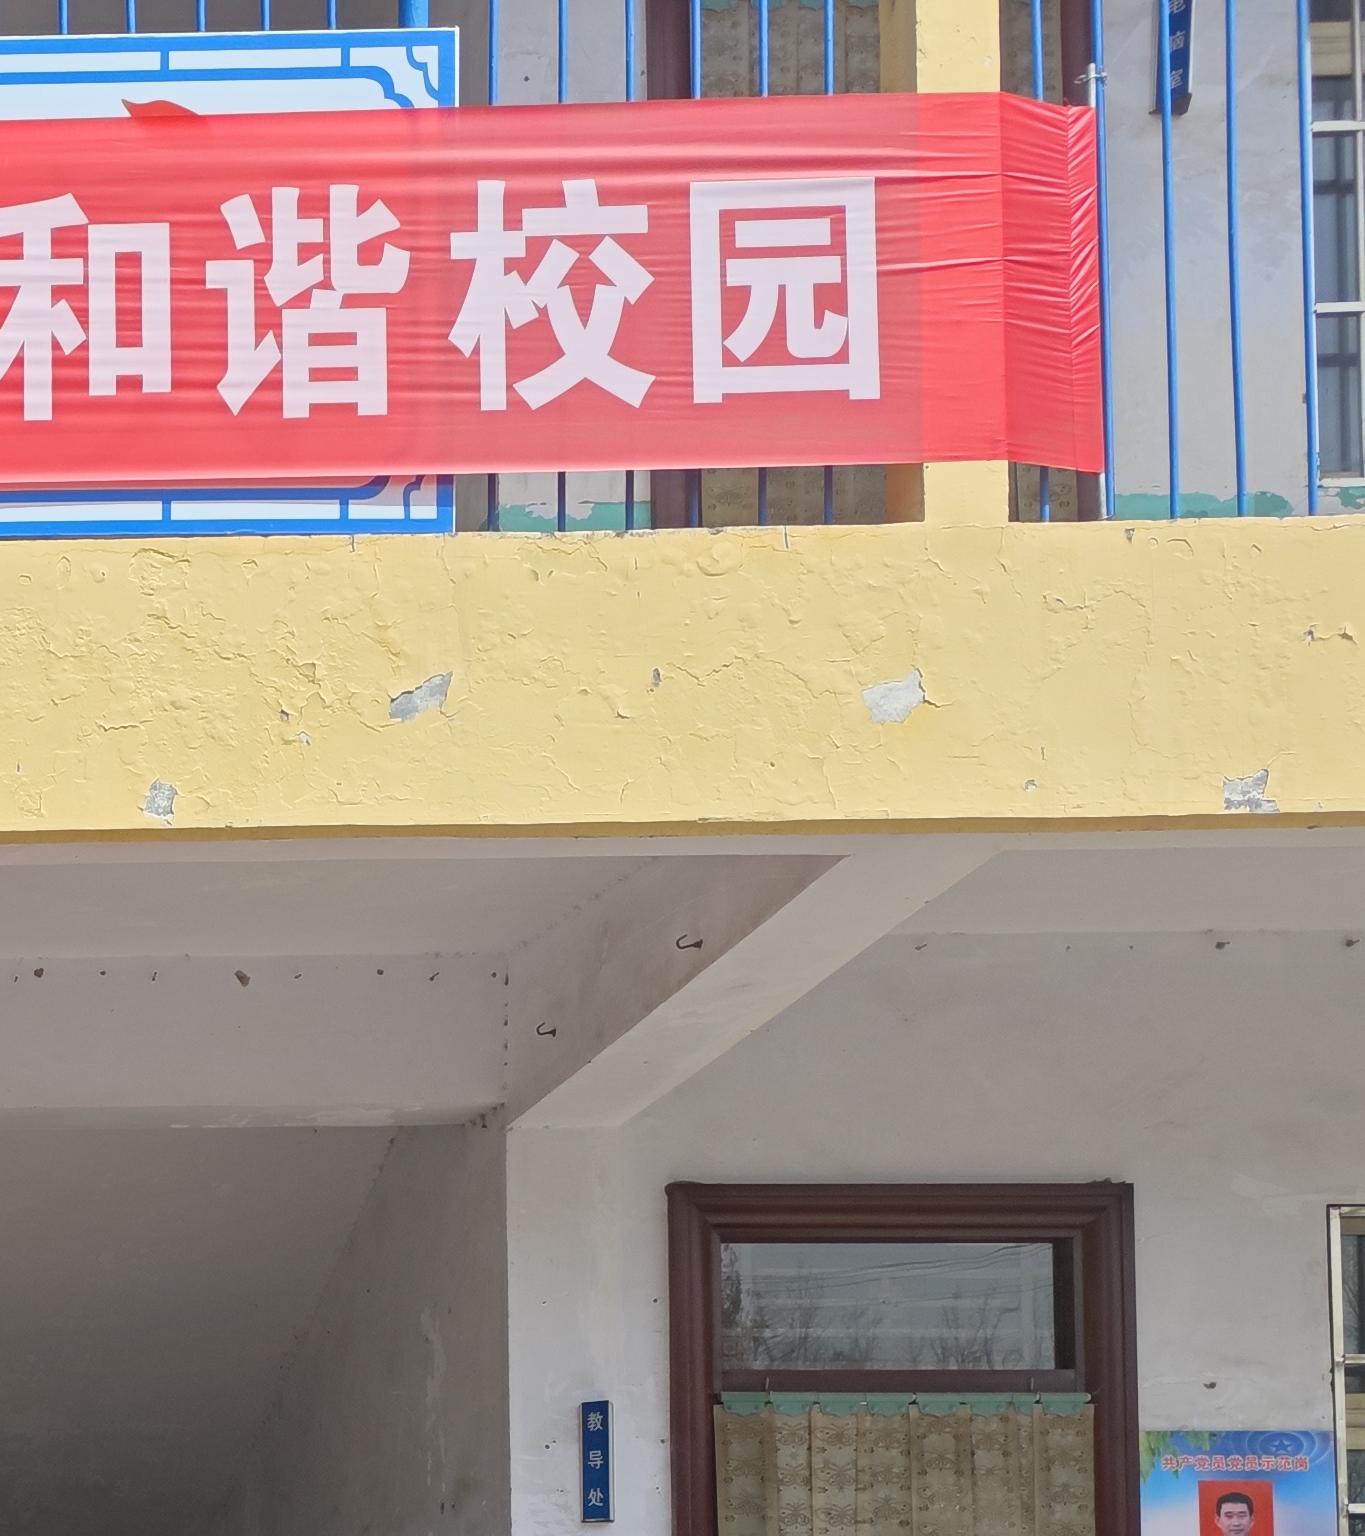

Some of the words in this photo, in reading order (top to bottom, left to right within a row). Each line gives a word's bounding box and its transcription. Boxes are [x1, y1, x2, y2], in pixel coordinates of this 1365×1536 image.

[586, 1411, 604, 1507] 教导处
[1161, 1454, 1310, 1472] 共产党员党员示范岗
